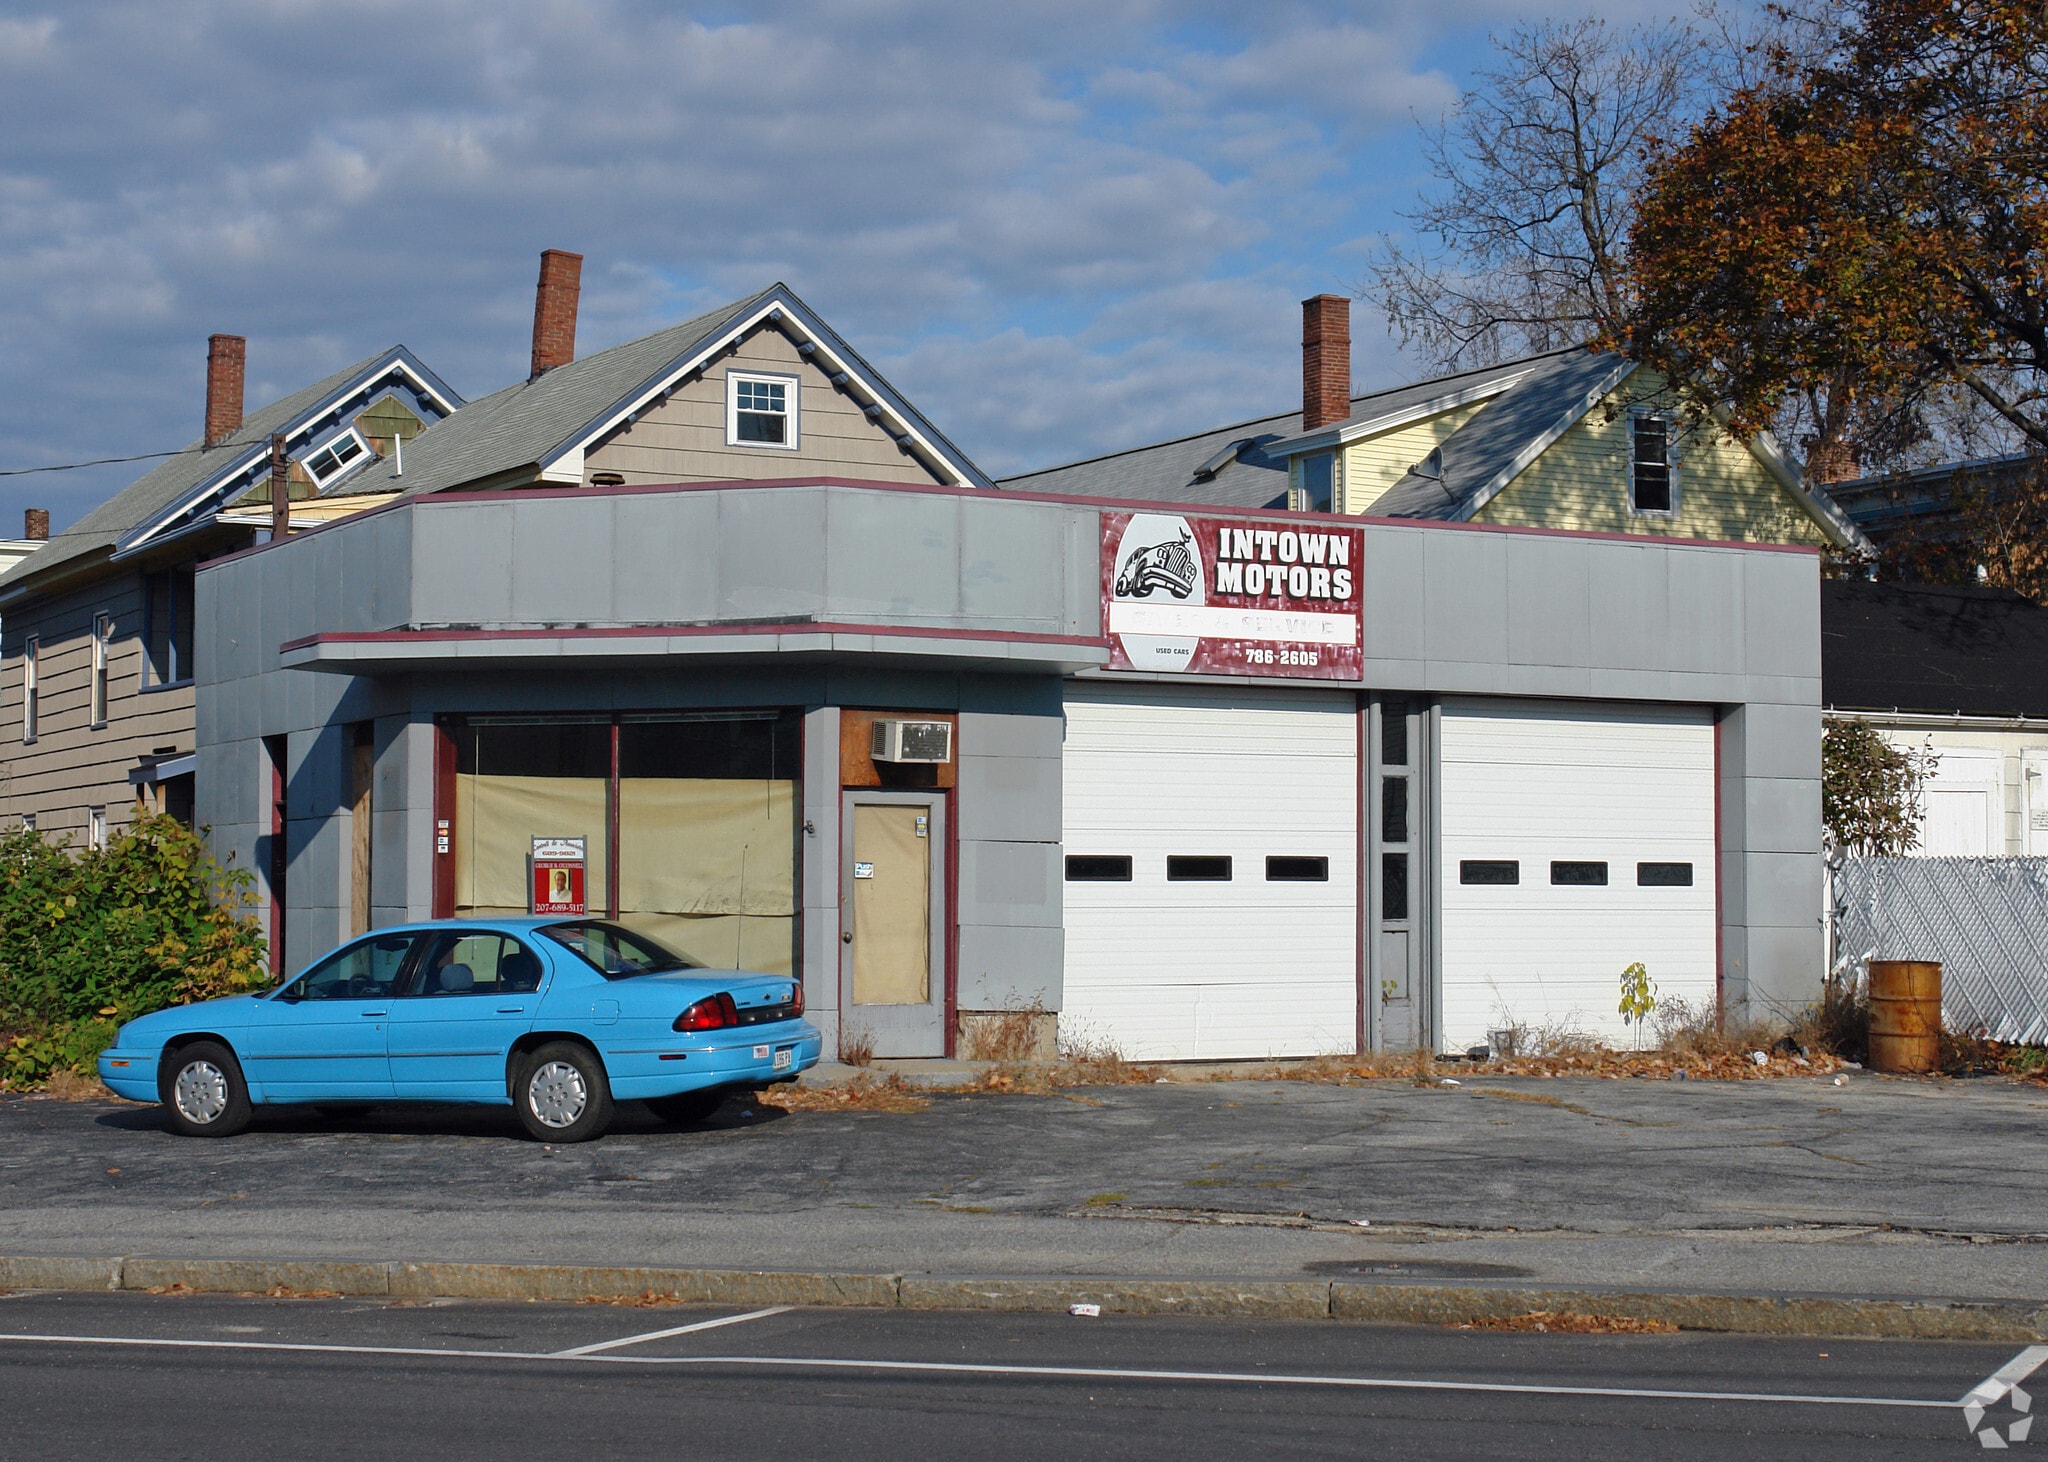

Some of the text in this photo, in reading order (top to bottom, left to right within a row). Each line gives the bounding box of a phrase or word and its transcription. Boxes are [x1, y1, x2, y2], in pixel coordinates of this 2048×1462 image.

[1217, 527, 1351, 567] INTOWN
[1215, 561, 1353, 601] MOTORS
[1155, 647, 1190, 656] USED CARS
[1244, 648, 1319, 667] 786-2605
[535, 903, 584, 912] 207-689-5117
